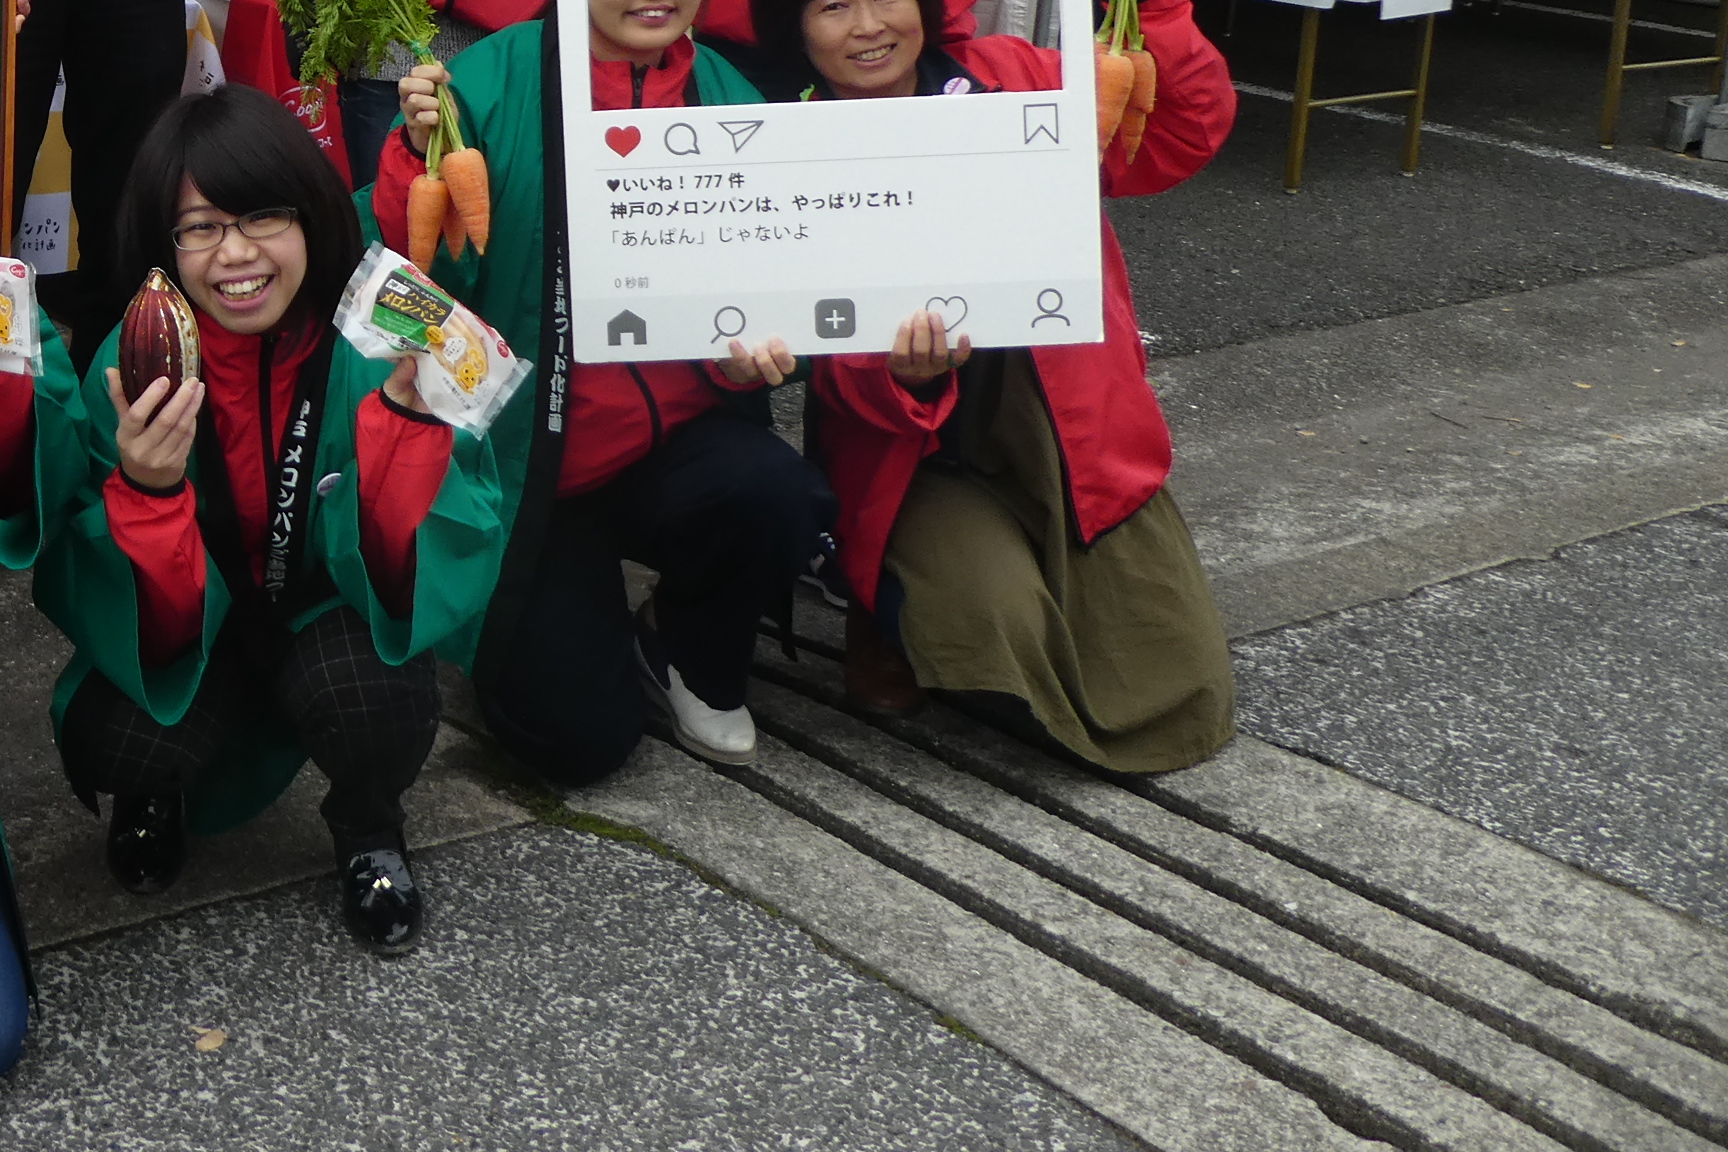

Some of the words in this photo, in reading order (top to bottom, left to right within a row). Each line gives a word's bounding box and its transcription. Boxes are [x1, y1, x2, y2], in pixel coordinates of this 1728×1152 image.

[694, 174, 723, 189] 777
[728, 172, 746, 189] 件
[378, 292, 439, 325] メロンパン
[409, 292, 447, 317] ハイカラ
